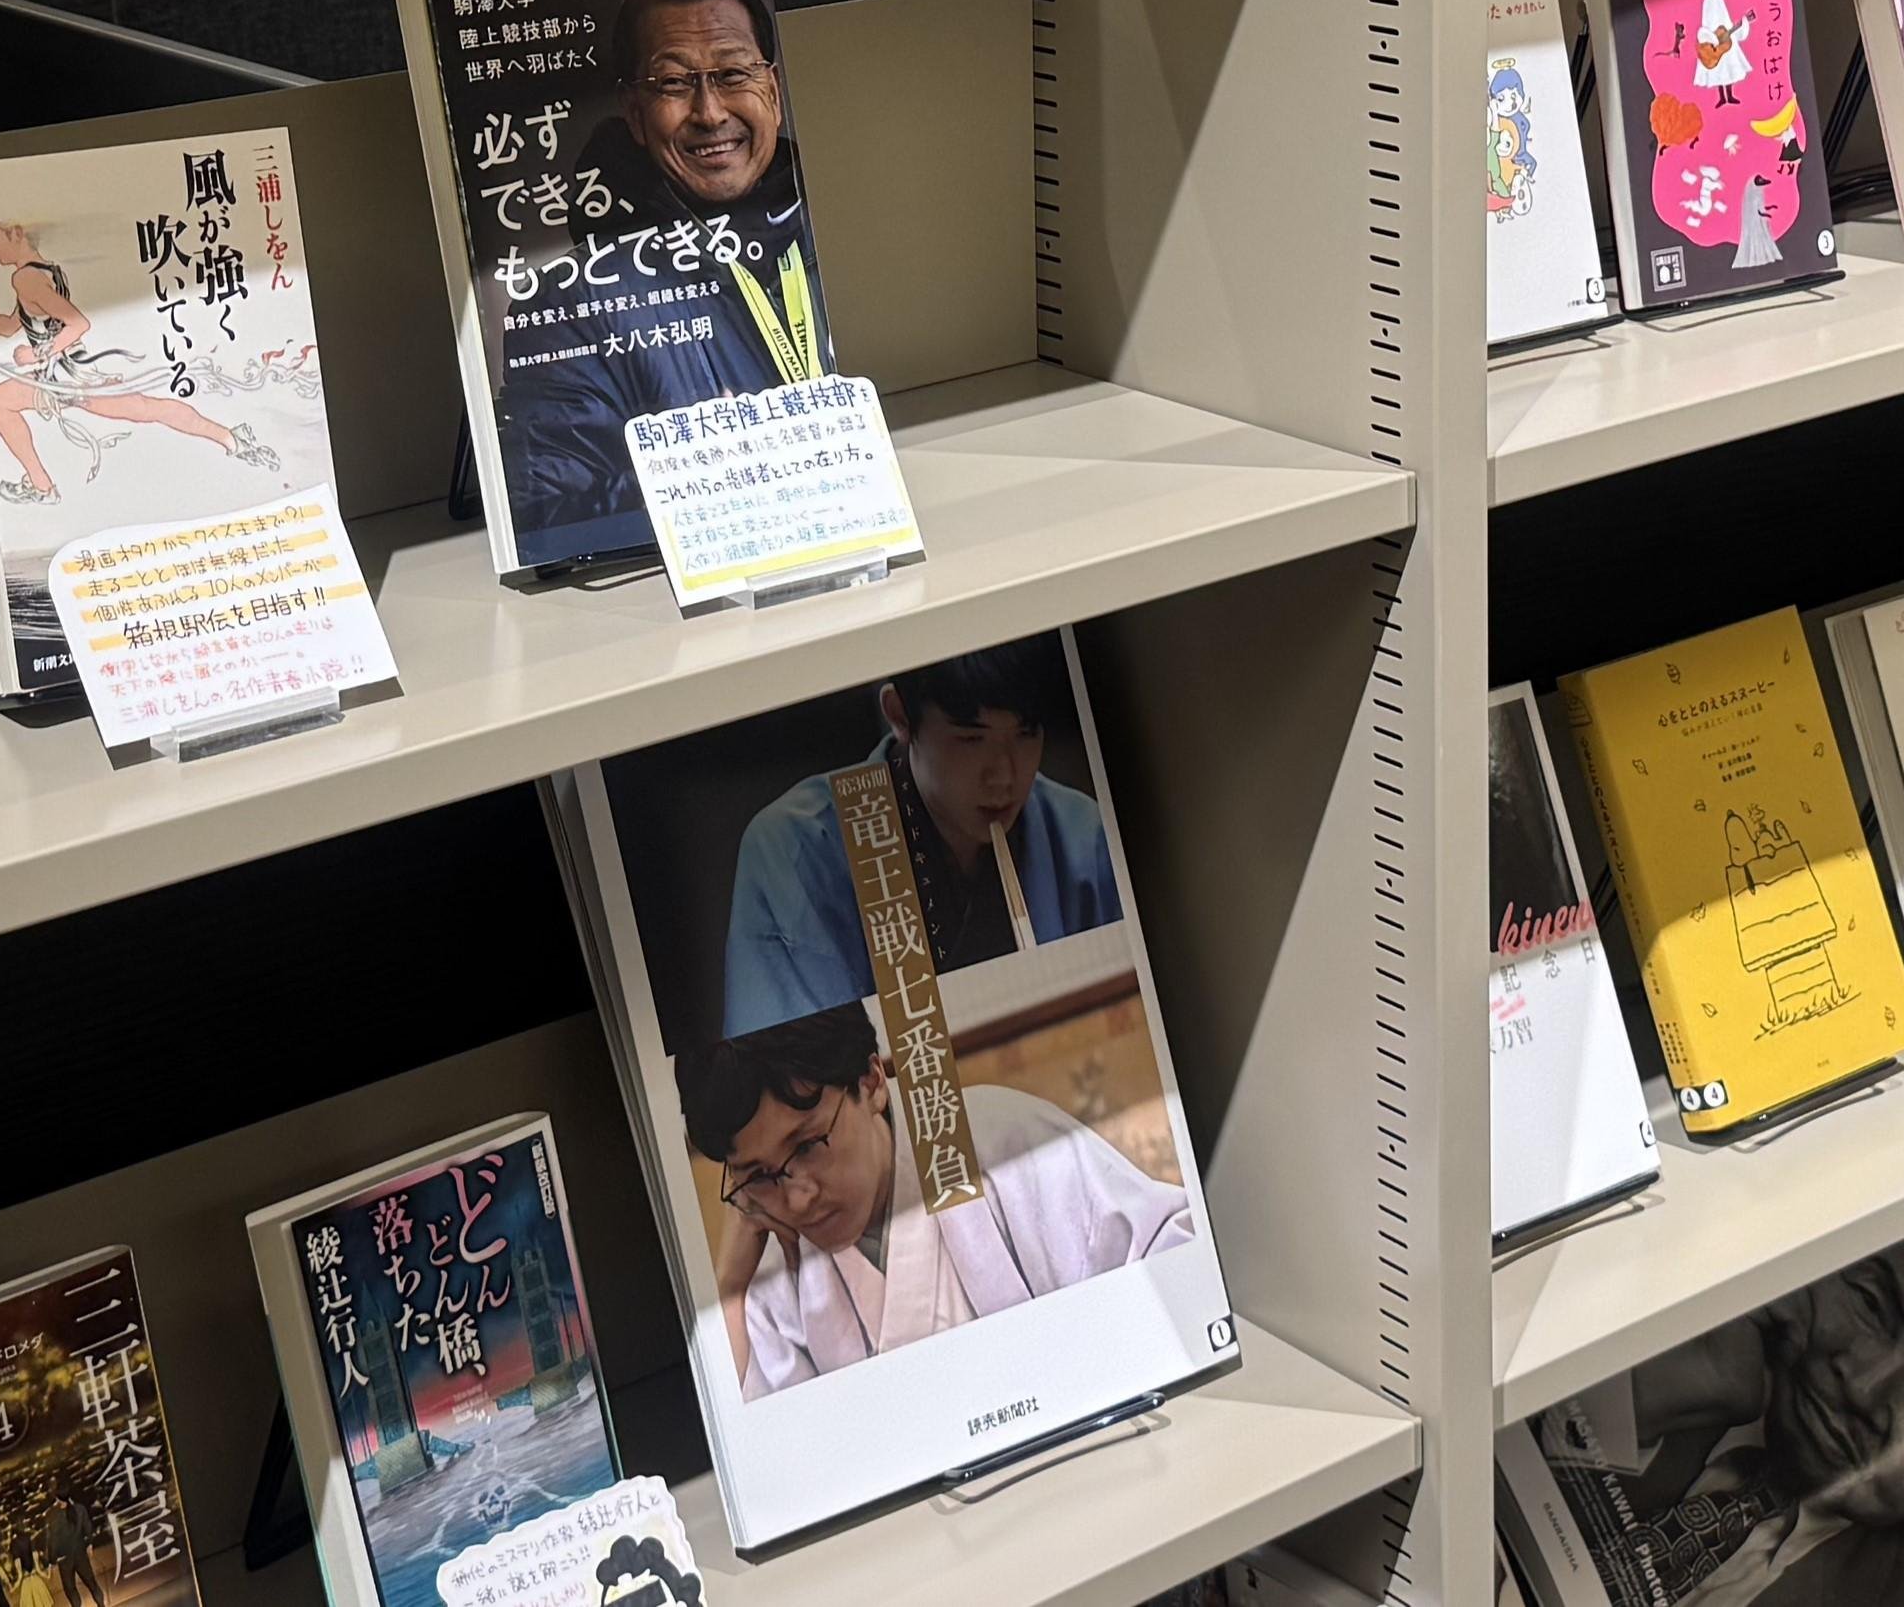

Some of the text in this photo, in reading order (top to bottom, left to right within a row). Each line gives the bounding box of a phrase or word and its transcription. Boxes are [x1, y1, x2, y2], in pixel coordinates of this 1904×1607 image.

[458, 13, 598, 50] 陸上競技部から
[464, 46, 598, 82] 世界へ羽ばたく
[472, 99, 572, 171] 必ず
[253, 144, 295, 292] 三浦しをん
[480, 166, 635, 231] できる、
[182, 148, 250, 342] 風が強く
[492, 212, 765, 302] もっとできる。
[135, 213, 198, 398] 吹いている
[602, 315, 714, 358] 大八木弘明
[833, 767, 888, 797] 第36期
[842, 794, 978, 1209] 竜王戦七番勝負
[305, 1225, 371, 1399] 綾辻行人
[64, 1267, 181, 1586] 三軒茶屋
[966, 1395, 1041, 1438] 読売新聞社
[1601, 1473, 1639, 1532] KAWAI
